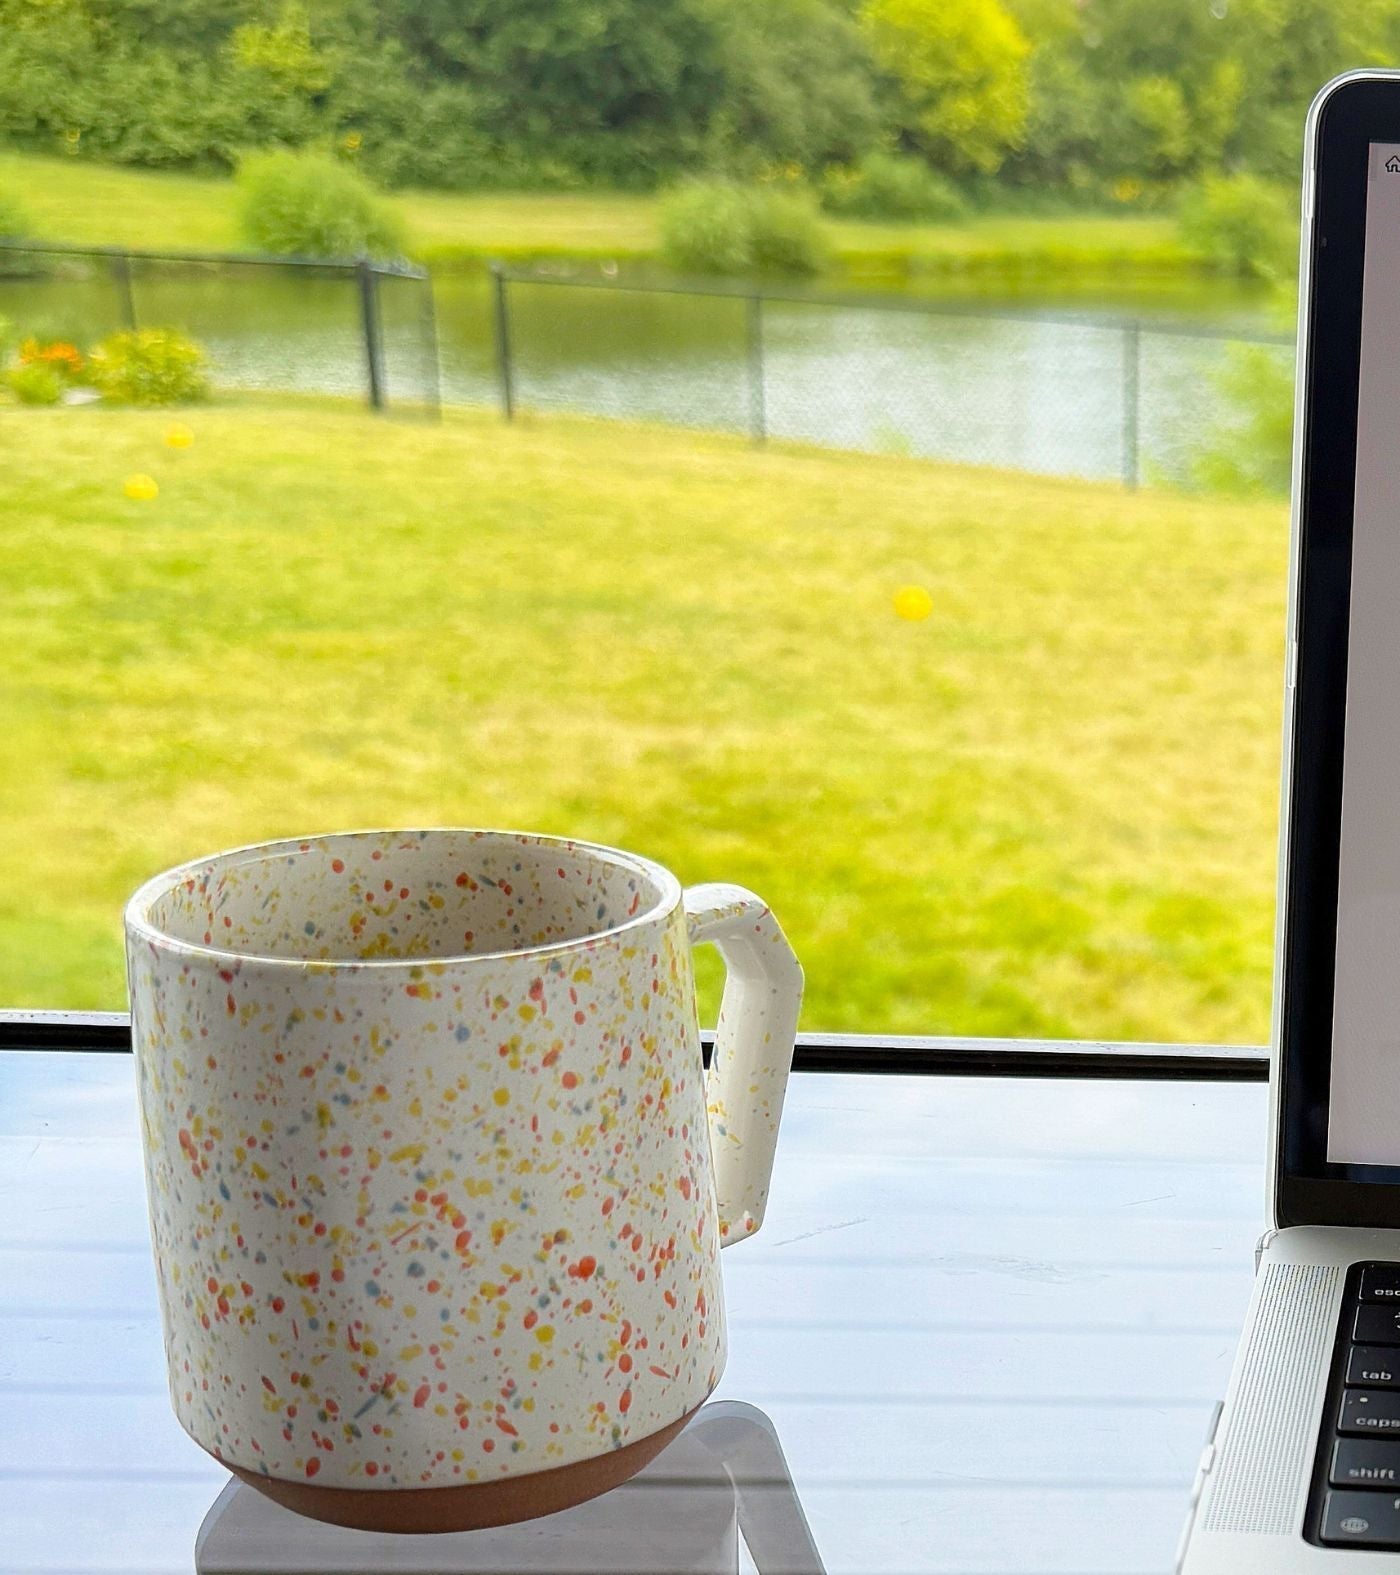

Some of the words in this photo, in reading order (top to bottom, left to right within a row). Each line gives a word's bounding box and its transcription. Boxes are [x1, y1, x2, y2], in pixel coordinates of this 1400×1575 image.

[1362, 1370, 1392, 1380] tab
[1355, 1417, 1400, 1431] caps
[1348, 1468, 1394, 1481] shift
